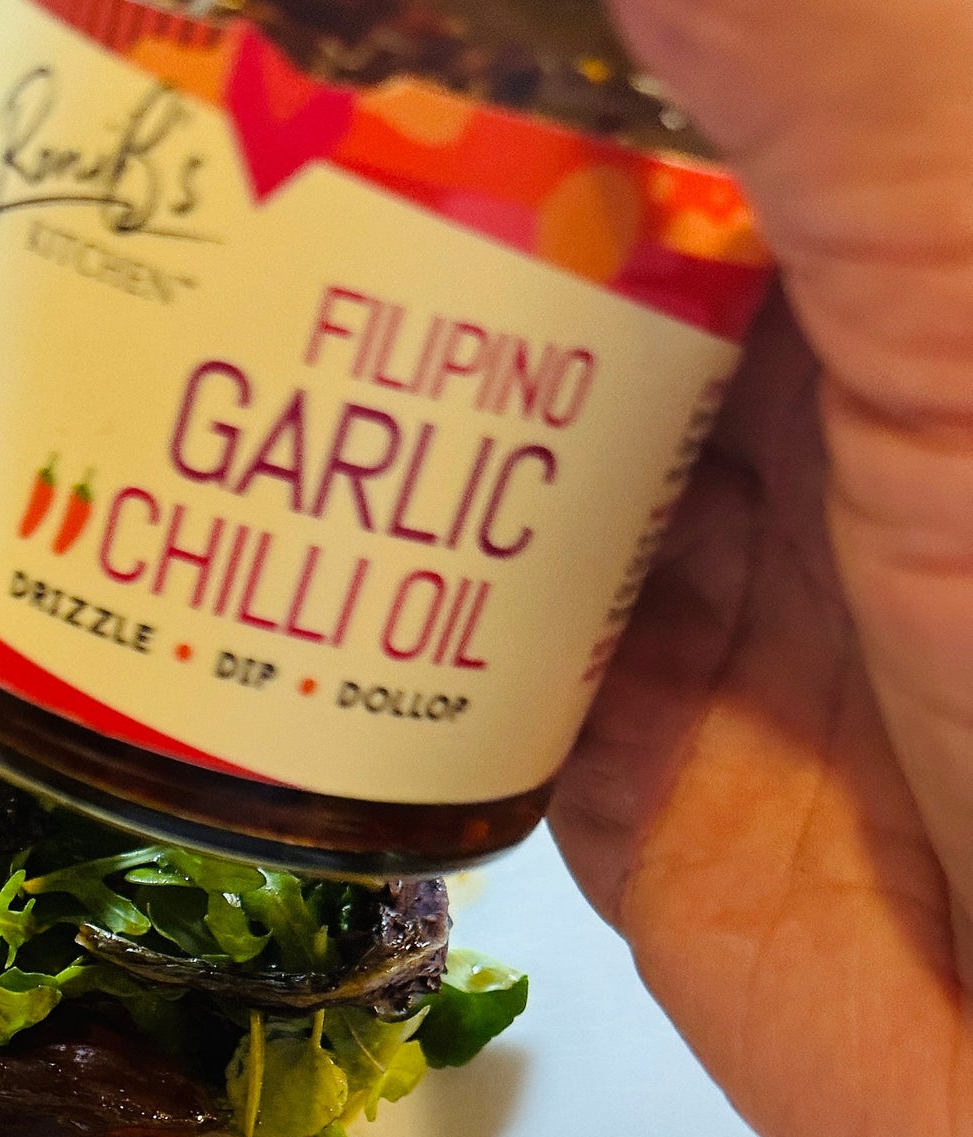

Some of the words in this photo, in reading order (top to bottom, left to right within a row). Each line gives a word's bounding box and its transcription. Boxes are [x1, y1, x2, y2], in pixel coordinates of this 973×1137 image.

[302, 284, 598, 430] FILIPINO
[168, 359, 558, 560] GARLIC
[10, 569, 157, 655] DRIZZLE
[213, 650, 280, 690] DIP
[335, 680, 472, 724] DOLLOP
[98, 486, 372, 649] CHILLI
[379, 567, 493, 670] OIL
